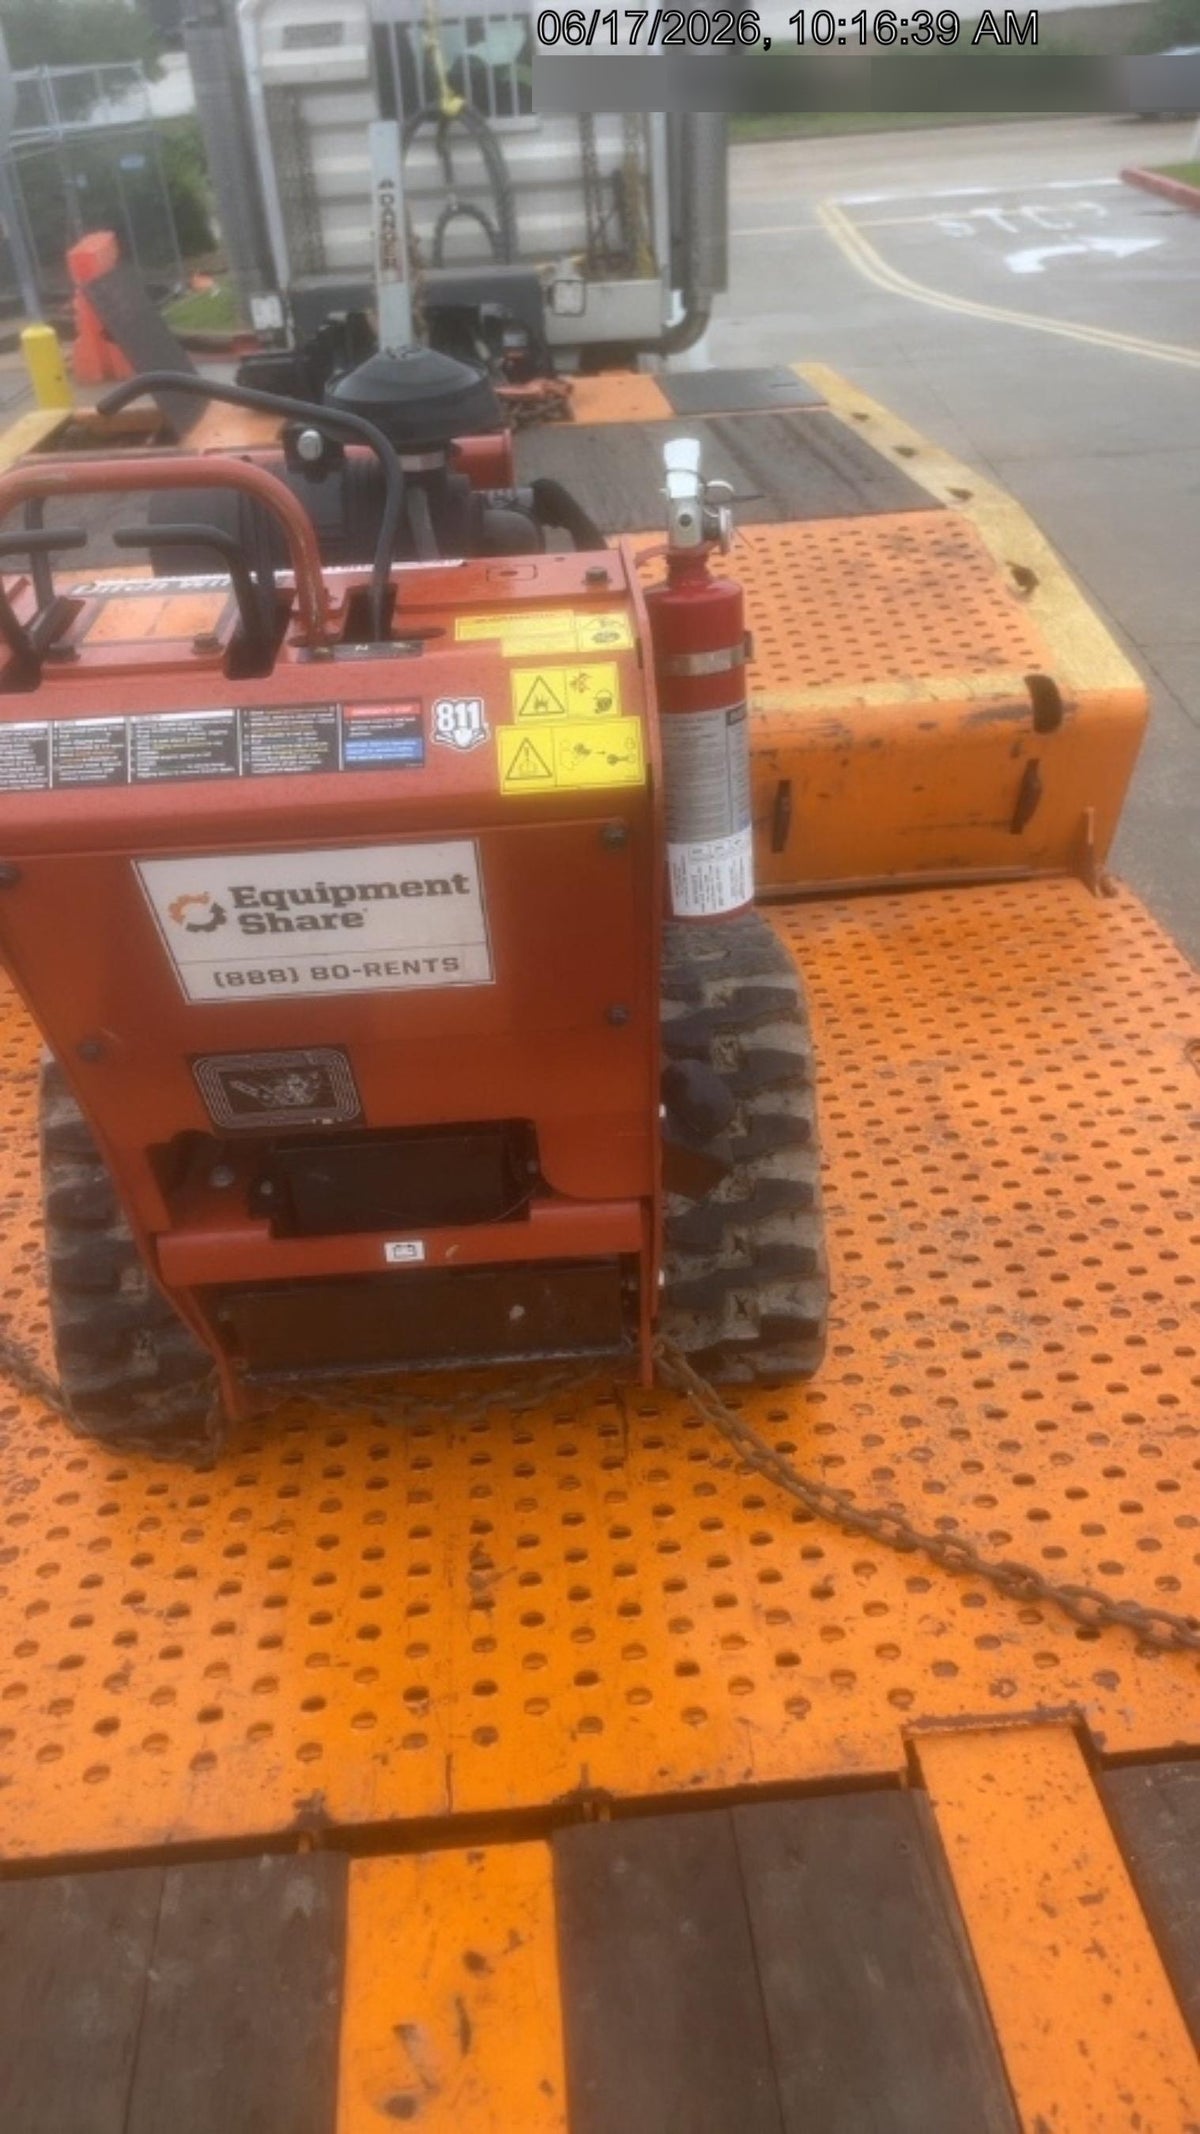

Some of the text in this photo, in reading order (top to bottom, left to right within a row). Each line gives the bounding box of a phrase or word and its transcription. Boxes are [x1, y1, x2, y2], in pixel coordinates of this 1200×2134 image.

[436, 700, 481, 732] 811
[228, 873, 471, 912] Equipment
[238, 910, 366, 935] Share
[213, 957, 460, 988] (888) 80-RENTS
